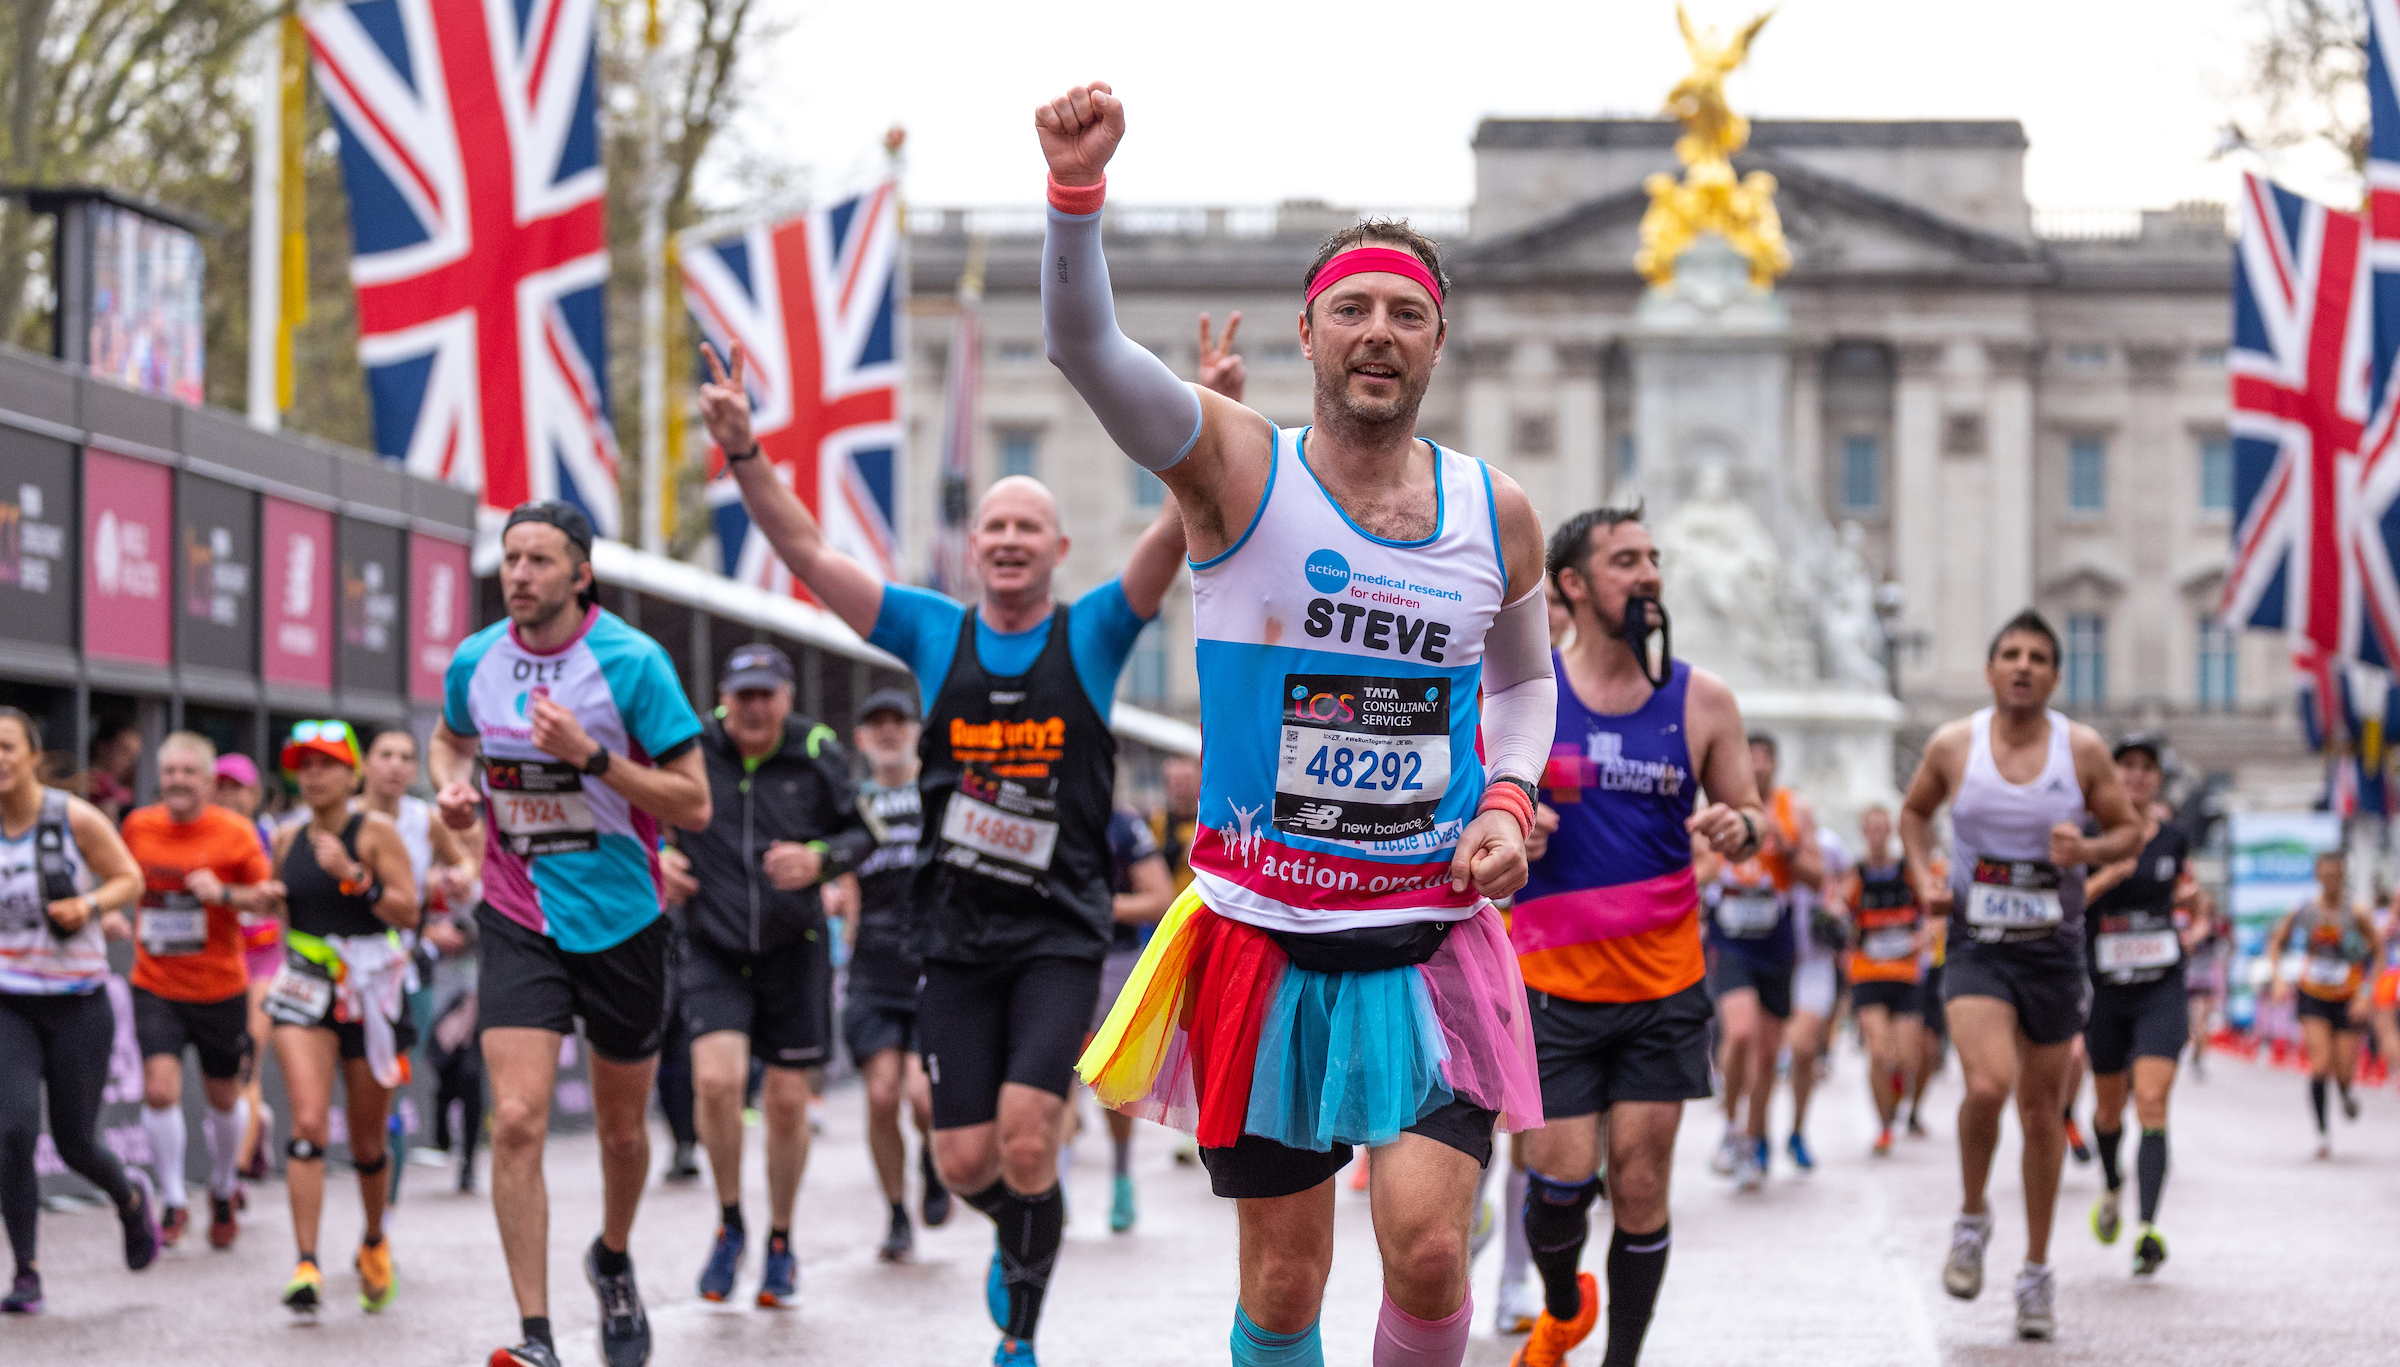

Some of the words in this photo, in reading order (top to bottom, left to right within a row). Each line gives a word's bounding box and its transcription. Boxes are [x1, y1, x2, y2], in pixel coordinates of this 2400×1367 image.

[1307, 563, 1348, 579] action
[1352, 572, 1406, 590] medical
[1408, 583, 1462, 602] research
[1350, 586, 1369, 599] for
[1371, 591, 1420, 609] children
[1304, 598, 1451, 663] STEVE
[1363, 686, 1400, 699] TATA
[1362, 700, 1439, 713] CONSULTANCY
[1361, 714, 1412, 727] SERVICES
[1305, 745, 1423, 791] 48292
[506, 799, 567, 824] 7924
[963, 811, 1036, 853] 14963
[1341, 821, 1372, 835] new
[1374, 817, 1421, 835] balance
[1422, 822, 1460, 848] lives
